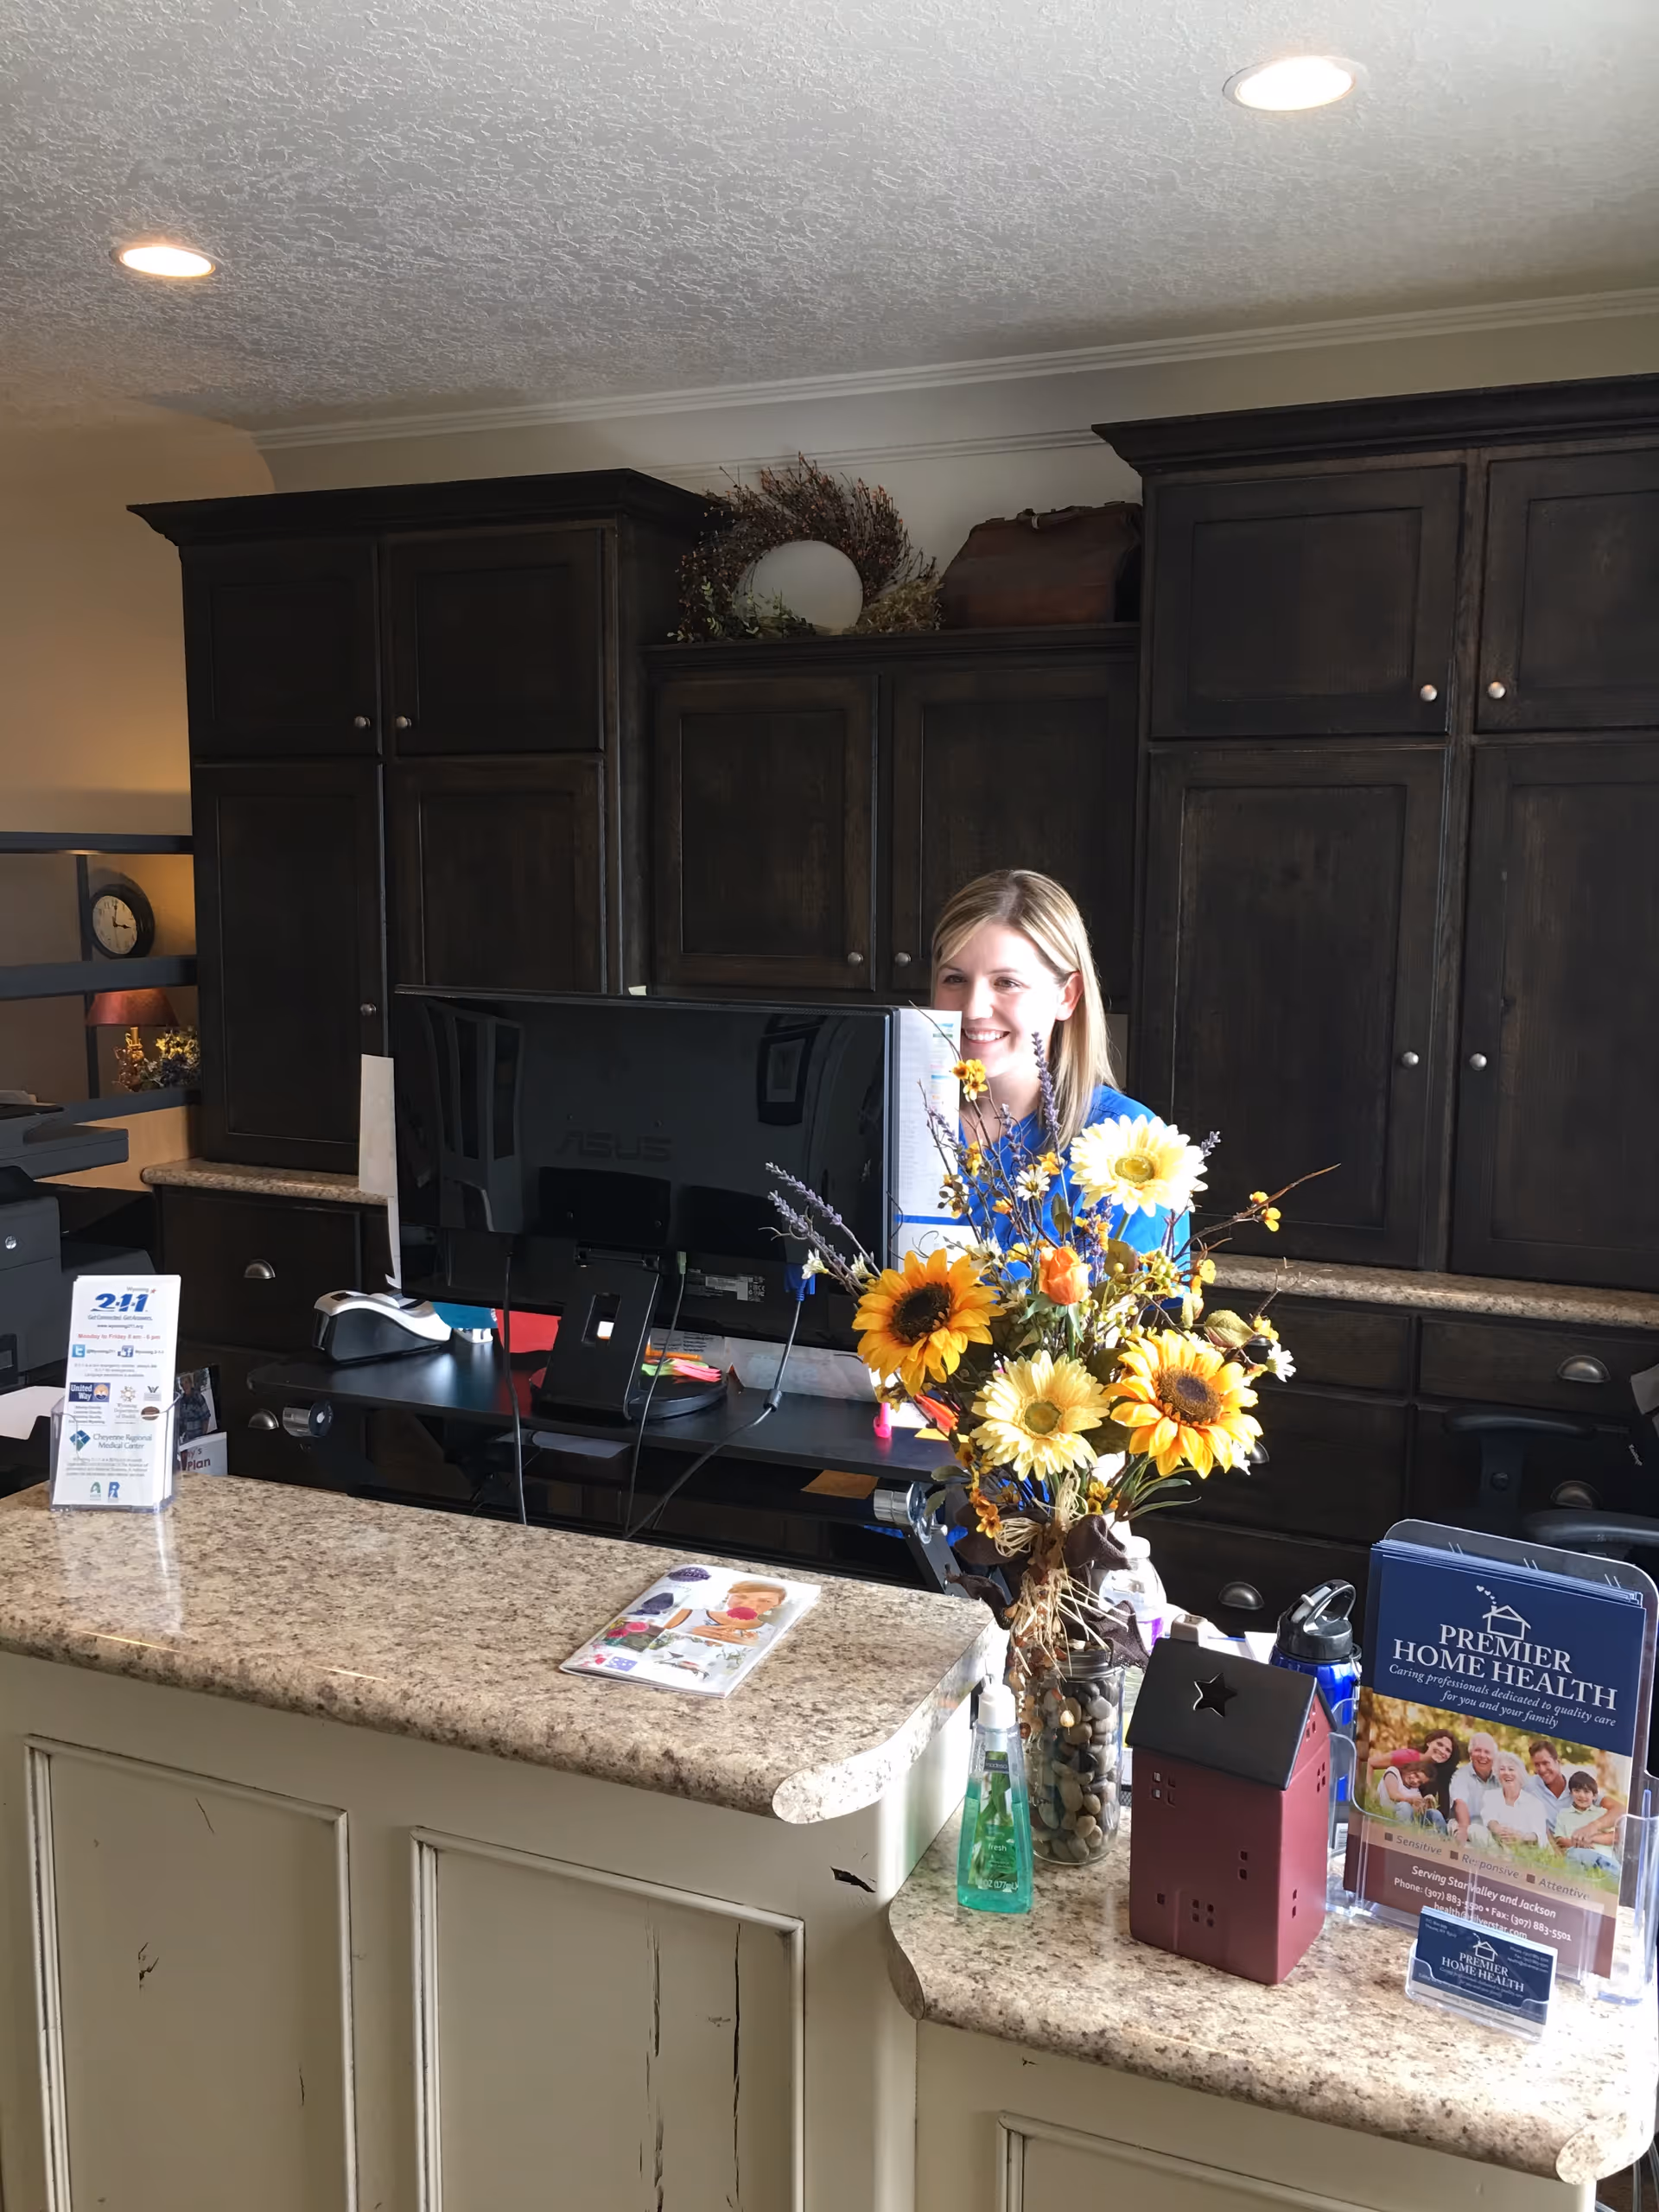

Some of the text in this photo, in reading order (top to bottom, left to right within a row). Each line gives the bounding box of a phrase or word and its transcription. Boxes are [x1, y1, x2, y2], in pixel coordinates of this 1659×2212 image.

[78, 1392, 92, 1401] Way
[93, 1433, 152, 1443] Cheyenne Regional
[187, 1458, 211, 1471] Plan
[1439, 1624, 1573, 1674] PREMIER
[1392, 1638, 1618, 1711] HOME HEALTH
[1389, 1663, 1617, 1727] Caring professionals dedicated to quality care
[1440, 1690, 1559, 1729] for you and your family
[988, 1842, 1007, 1852] fresh
[1396, 1835, 1442, 1856] Sensitive
[1462, 1853, 1519, 1879] Reponsive
[1411, 1866, 1447, 1885] Serving
[1447, 1876, 1468, 1891] Star
[1499, 1894, 1517, 1907] and
[1518, 1898, 1557, 1919] Jackson
[1394, 1877, 1423, 1893] Phone:
[1424, 1887, 1445, 1901] (307)
[1491, 1907, 1510, 1920] Fax:
[1510, 1914, 1532, 1929] (307)
[1533, 1921, 1572, 1942] 883-5502
[1441, 1956, 1477, 1977] HOME
[1478, 1968, 1525, 1993] HEALTH
[1459, 1951, 1509, 1977] PREMIER
